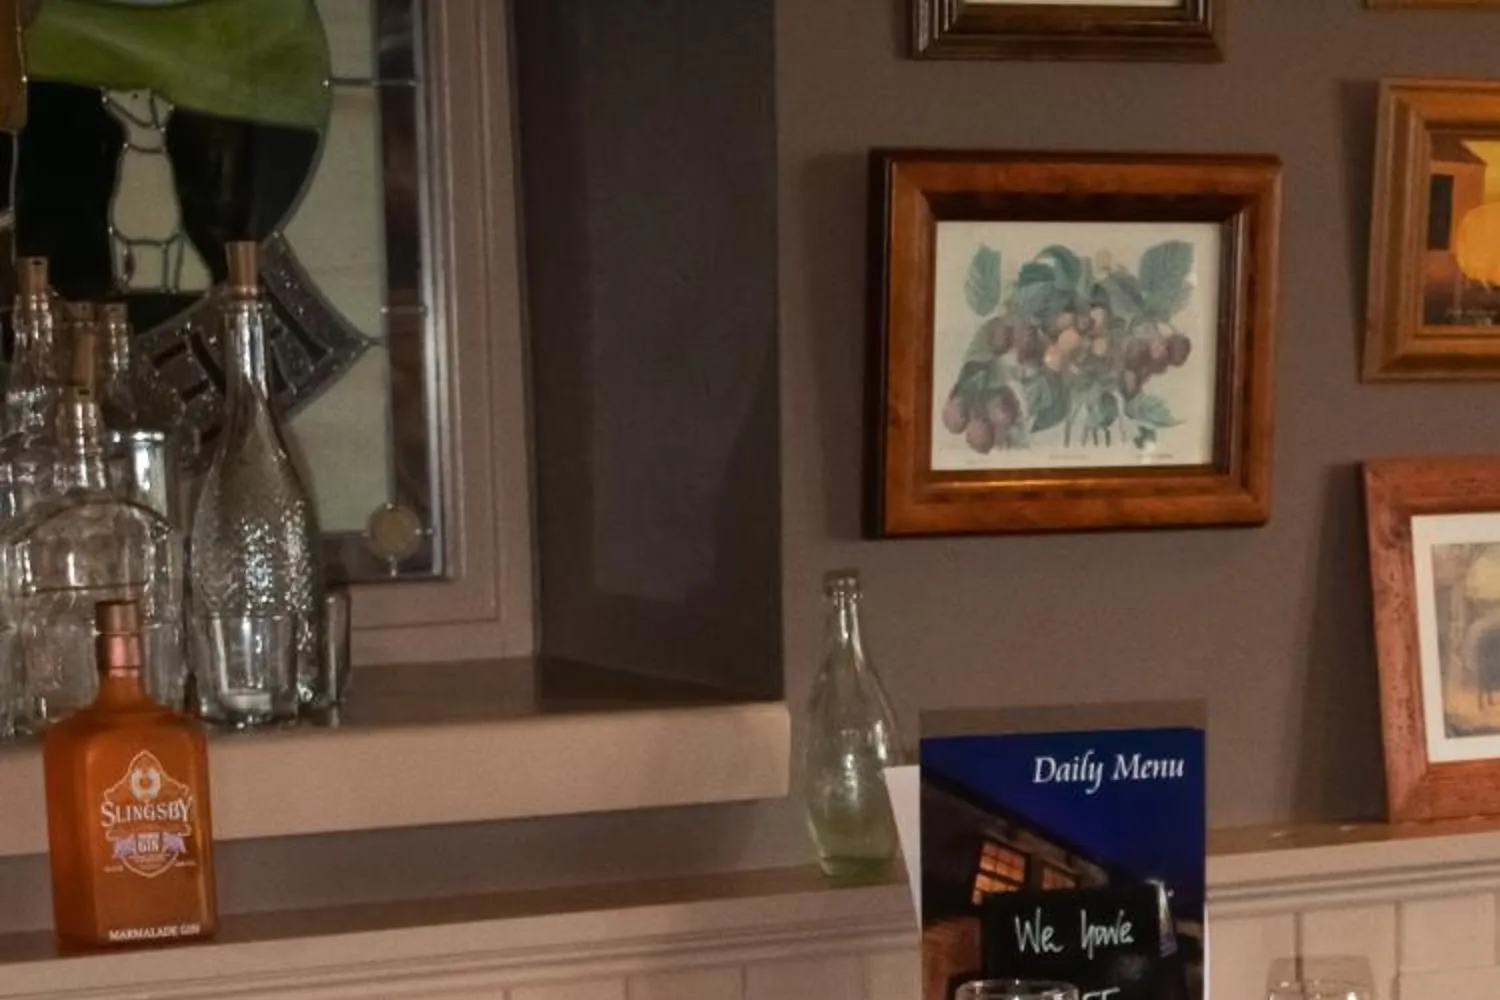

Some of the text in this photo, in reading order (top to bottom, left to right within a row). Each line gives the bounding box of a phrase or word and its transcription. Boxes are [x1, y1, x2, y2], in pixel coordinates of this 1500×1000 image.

[1032, 749, 1185, 795] Daily Menu
[1015, 905, 1064, 954] We
